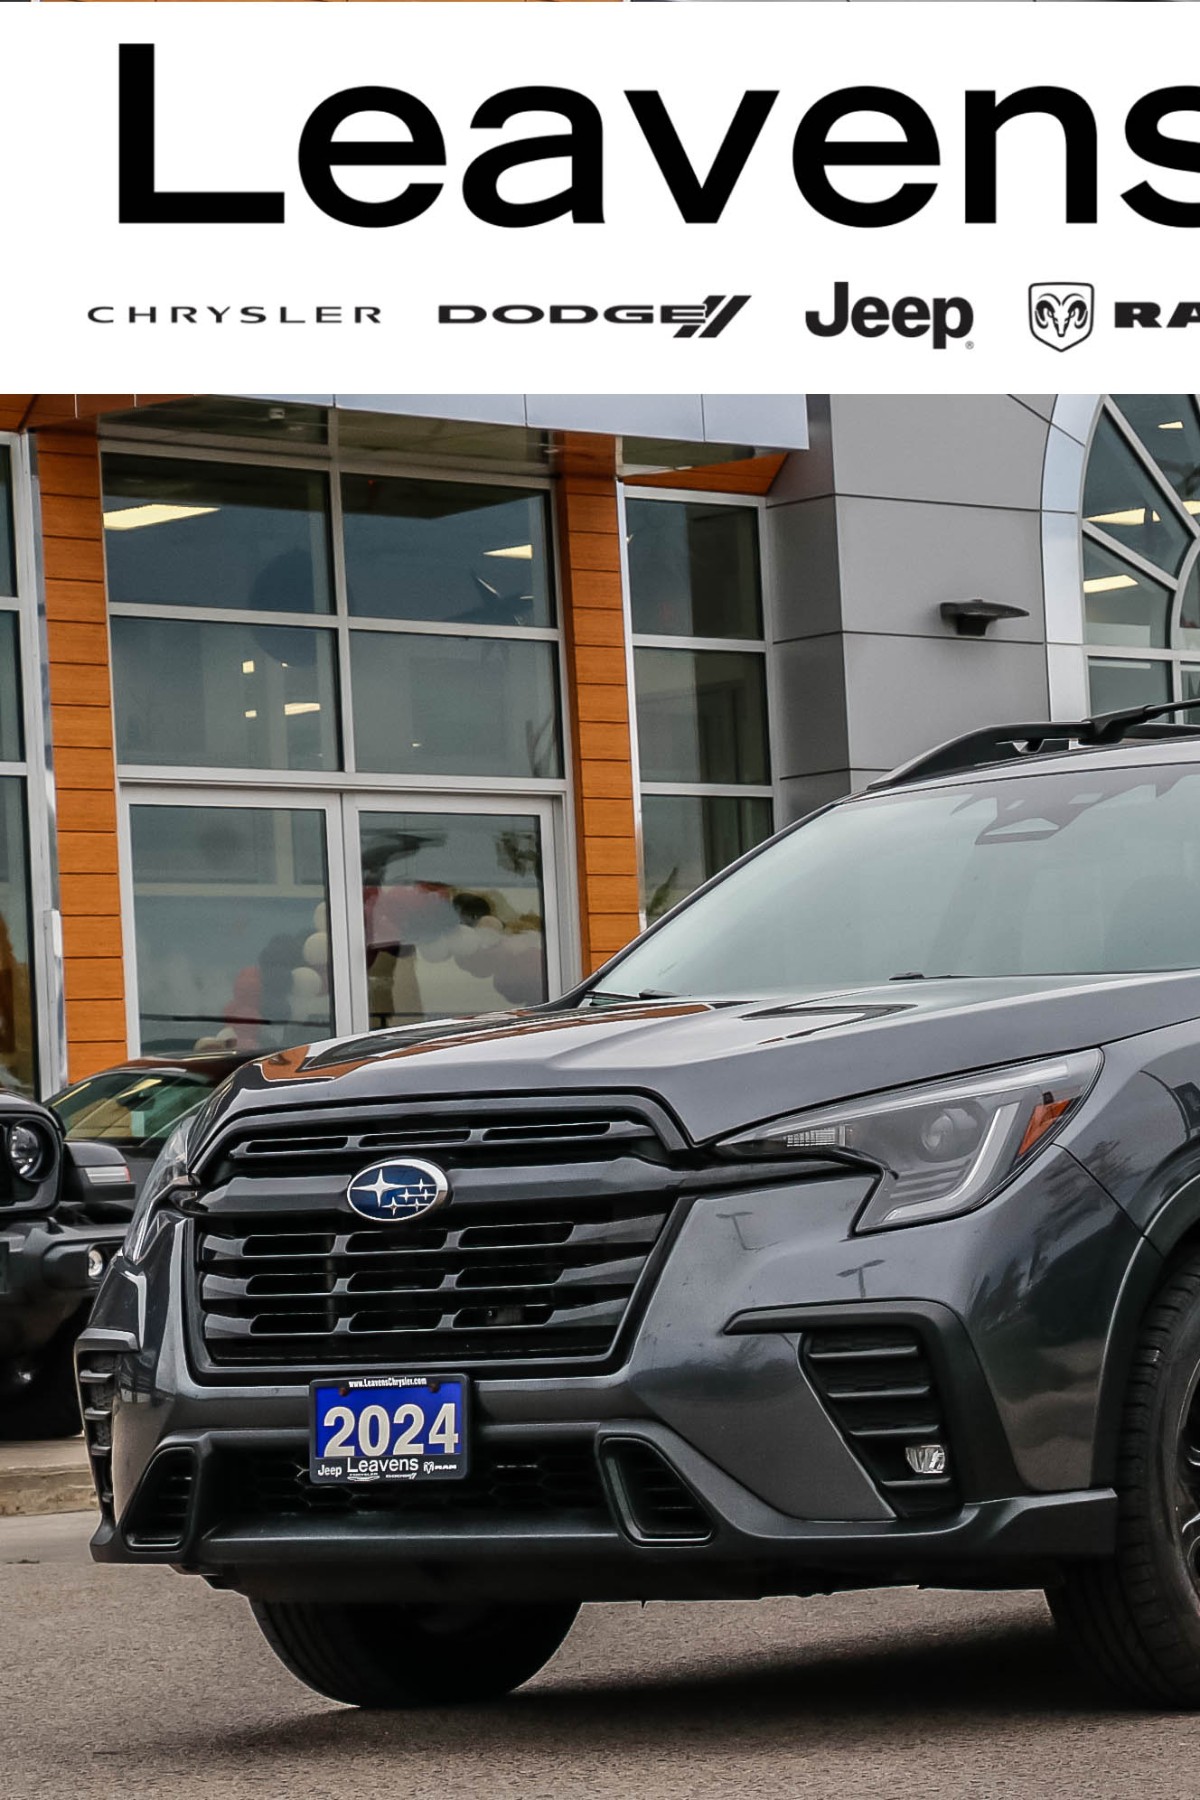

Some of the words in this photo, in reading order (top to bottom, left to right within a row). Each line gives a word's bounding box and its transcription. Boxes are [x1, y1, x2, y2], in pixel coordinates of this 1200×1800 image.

[348, 1377, 427, 1388] www.LeavensChrysler.com
[323, 1403, 459, 1458] 2024
[317, 1465, 342, 1477] Jeep
[347, 1456, 419, 1473] Leavens
